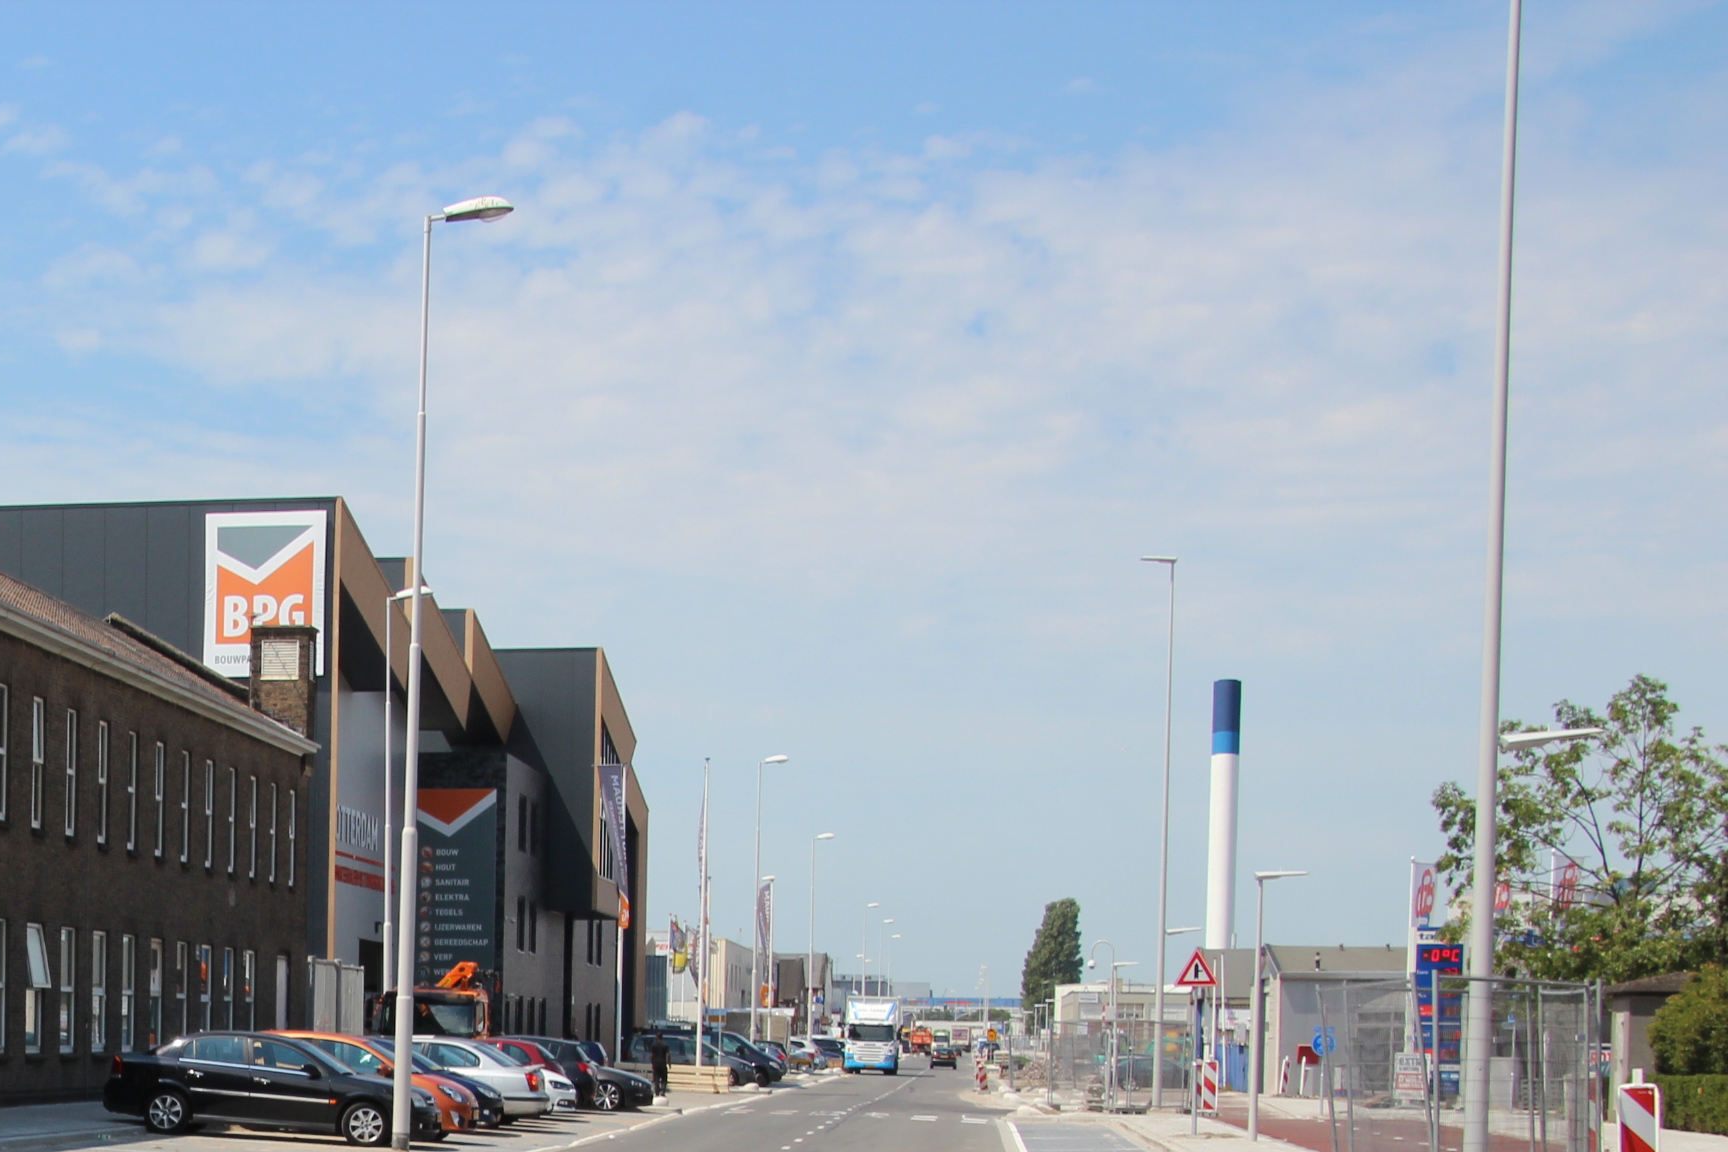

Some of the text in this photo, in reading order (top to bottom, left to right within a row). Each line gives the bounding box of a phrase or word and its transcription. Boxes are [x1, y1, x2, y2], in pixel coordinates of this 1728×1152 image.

[223, 593, 306, 638] BPG
[436, 848, 458, 857] BOUW
[436, 863, 455, 872] HOUT
[435, 878, 469, 887] SANITAIR
[435, 893, 469, 902] ELEKTRA
[435, 908, 463, 917] TEGELS
[435, 923, 481, 931] IJZERWAREN
[435, 938, 488, 947] GEREEDSCHAP
[434, 953, 453, 962] VERF
